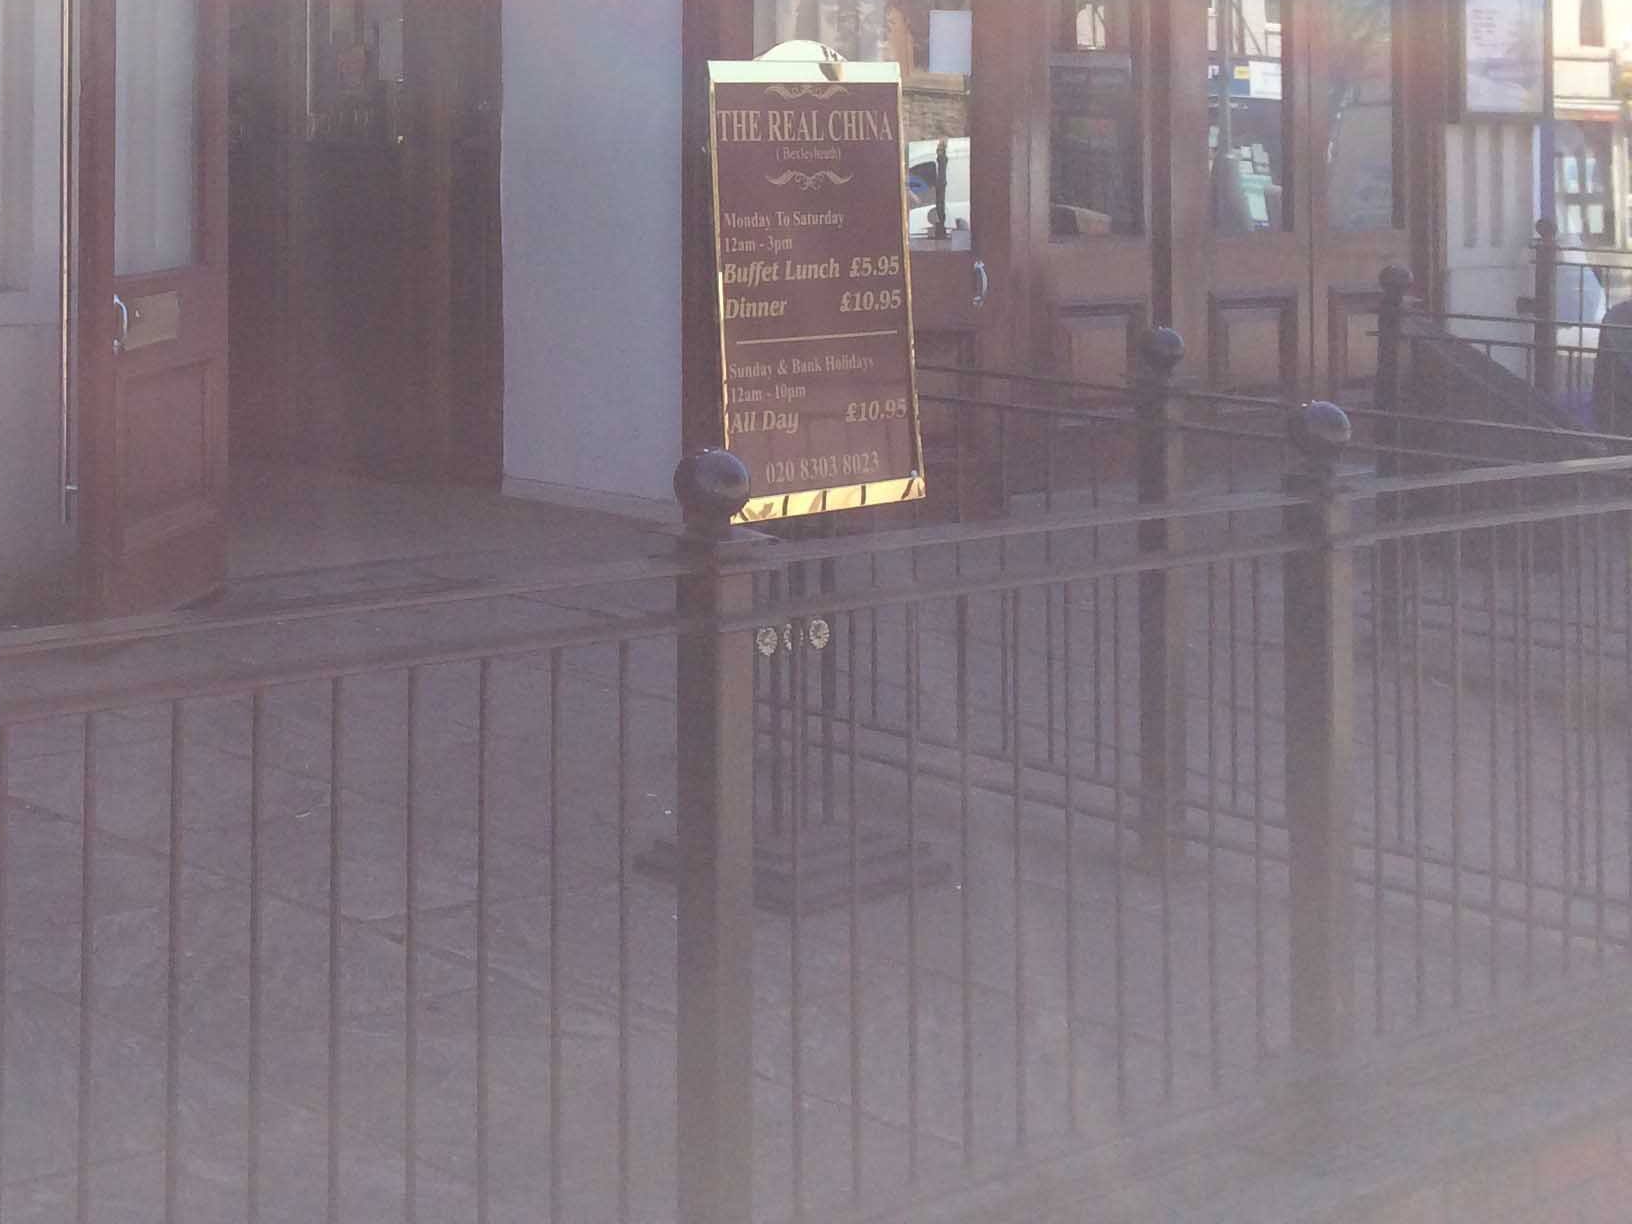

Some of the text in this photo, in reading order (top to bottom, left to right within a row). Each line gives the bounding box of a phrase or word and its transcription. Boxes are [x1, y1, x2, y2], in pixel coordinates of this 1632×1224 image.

[718, 109, 893, 142] THE REAL CHINA
[724, 209, 846, 231] Monday To Saturday
[724, 237, 756, 253] 12am
[767, 235, 793, 255] 3pm
[723, 255, 900, 288] Buffet Lunch £5.95
[724, 289, 902, 320] Dinner £10.95
[728, 353, 876, 380] Sunday & Bank Holidays
[730, 386, 763, 404] 12am
[730, 398, 908, 434] All Day £10.95
[766, 461, 796, 483] 020
